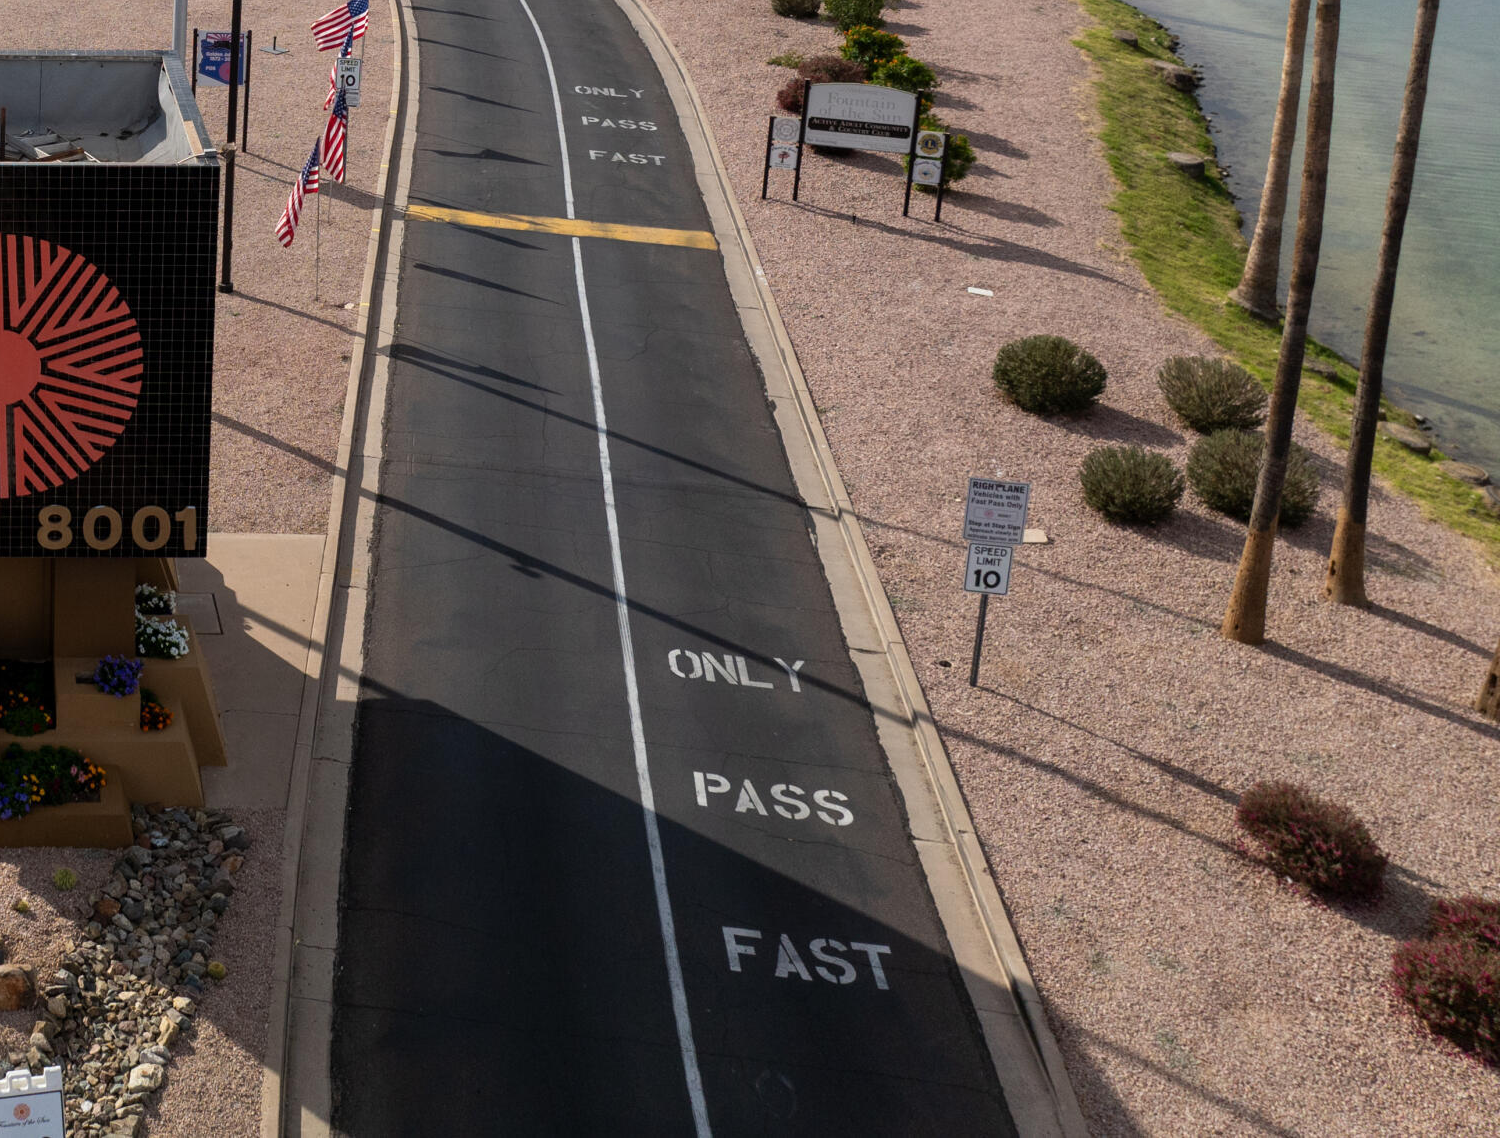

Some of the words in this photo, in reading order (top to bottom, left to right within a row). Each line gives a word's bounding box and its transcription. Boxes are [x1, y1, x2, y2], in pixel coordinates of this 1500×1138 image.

[341, 74, 355, 87] 10
[574, 85, 644, 99] ONLY
[828, 92, 896, 110] Fountain
[819, 105, 834, 117] of
[841, 106, 864, 120] the
[872, 109, 902, 122] Sun
[581, 116, 658, 131] PASS
[812, 118, 837, 126] ACTIVE
[841, 120, 863, 129] ADULT
[864, 123, 909, 133] COMMUNITY
[838, 126, 870, 135] COUNTRY
[871, 129, 892, 137] CLUB
[588, 149, 666, 166] FAST
[974, 490, 1003, 499] Vehicles
[1006, 493, 1020, 501] with
[1002, 484, 1025, 494] LANE
[971, 497, 987, 505] Fast
[1007, 502, 1023, 510] Only
[37, 505, 197, 550] 8001
[974, 546, 1007, 557] SPEED
[976, 557, 1002, 566] LIMIT
[974, 569, 1001, 588] 10
[668, 648, 805, 692] ONLY
[693, 771, 854, 826] PASS
[722, 926, 891, 990] FAST
